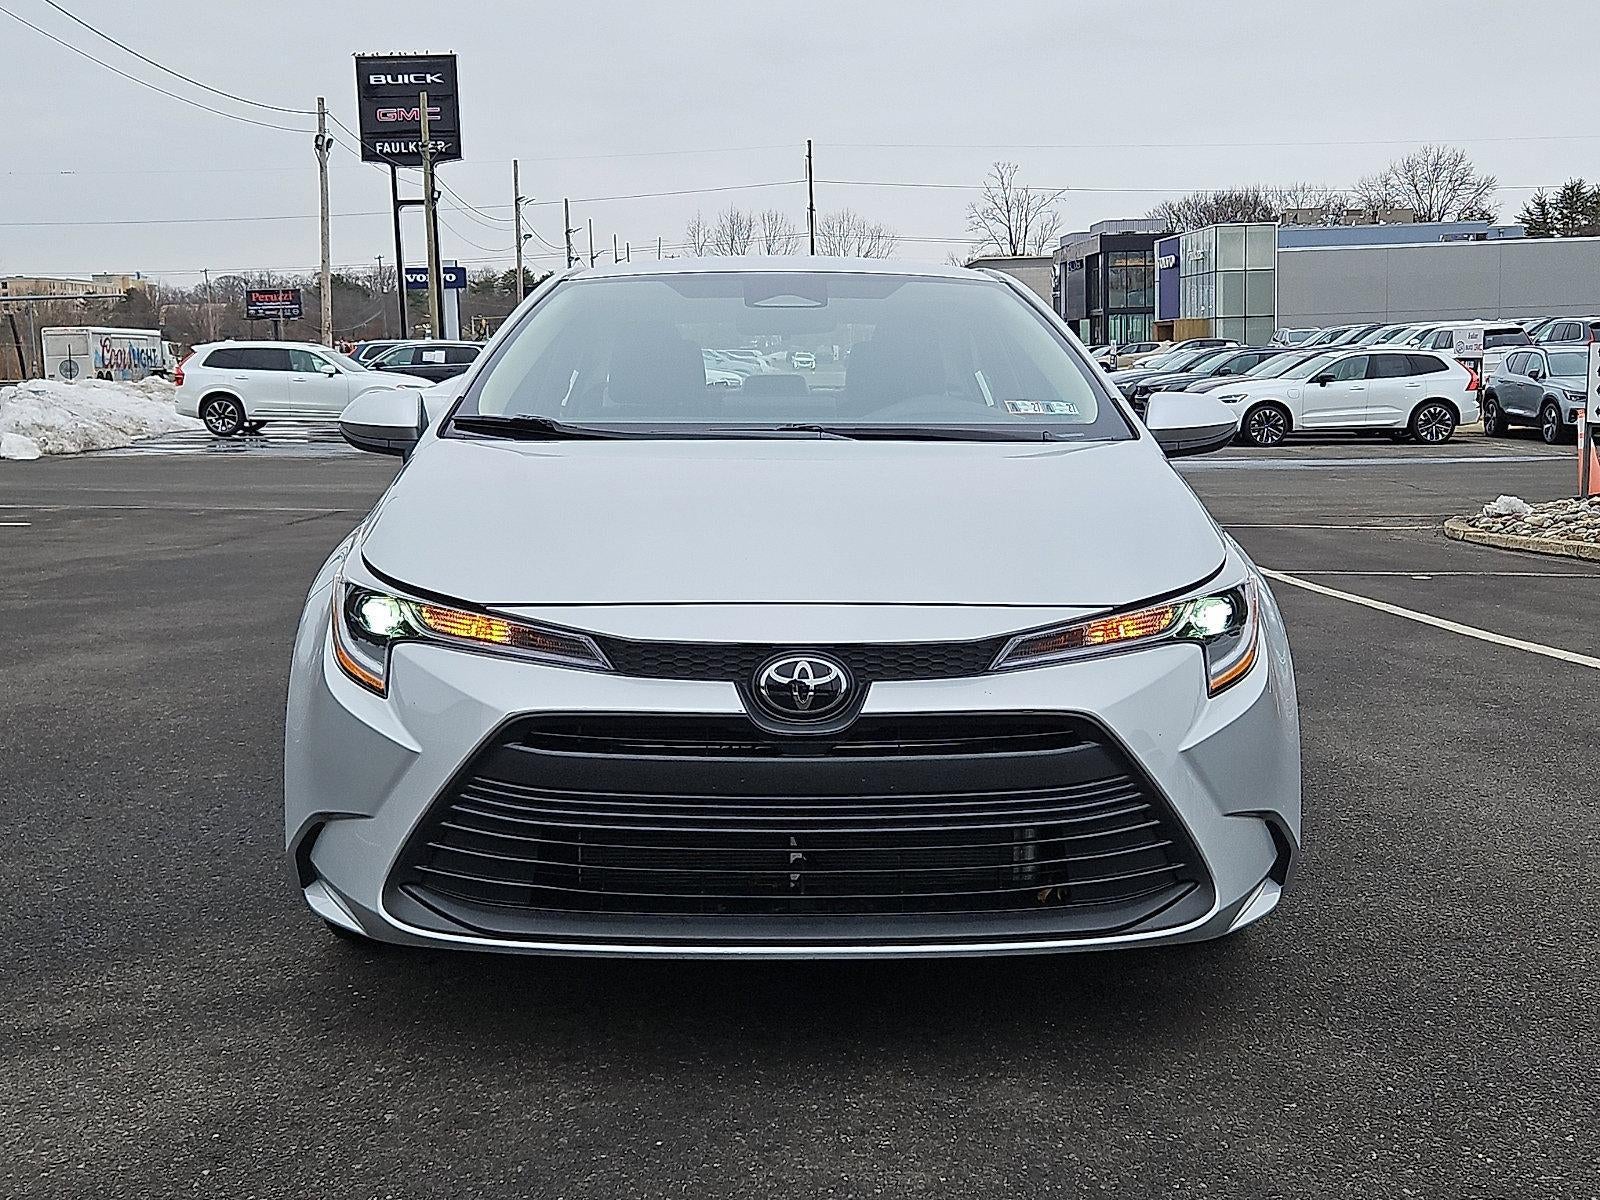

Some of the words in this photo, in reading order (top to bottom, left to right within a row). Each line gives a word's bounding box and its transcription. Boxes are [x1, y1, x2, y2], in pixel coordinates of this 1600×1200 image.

[369, 73, 444, 85] BUICK
[376, 107, 441, 121] GMC
[405, 273, 457, 283] VOO
